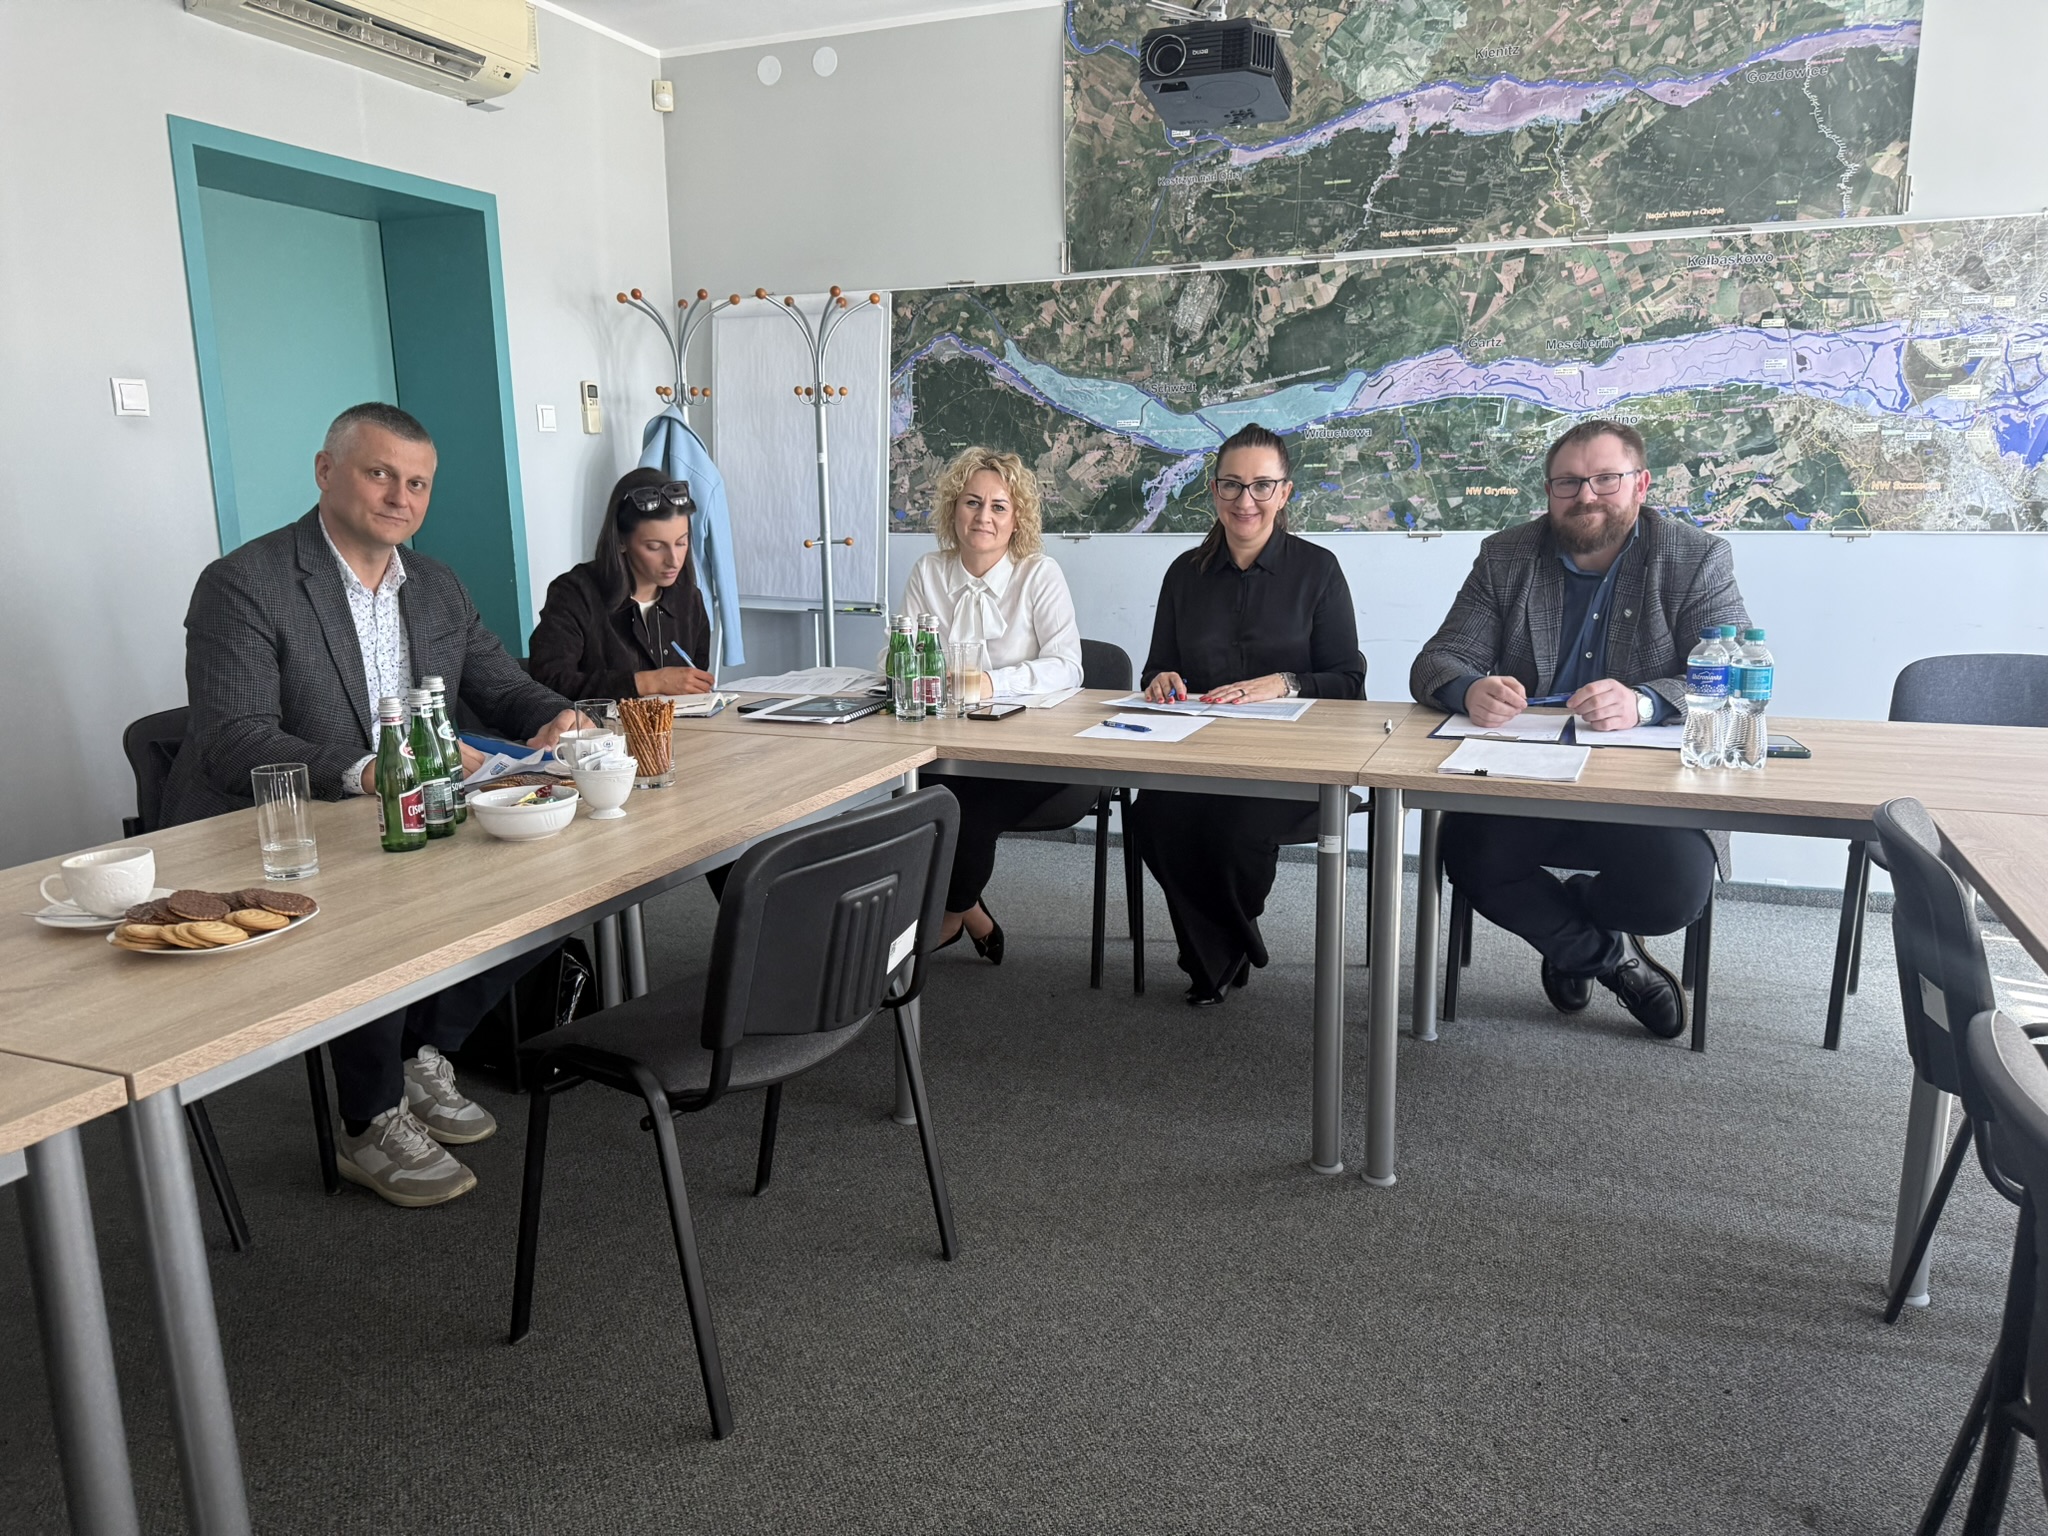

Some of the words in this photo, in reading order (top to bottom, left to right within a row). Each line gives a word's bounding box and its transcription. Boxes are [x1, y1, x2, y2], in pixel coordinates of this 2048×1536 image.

[1475, 44, 1520, 59] Kienitz
[1747, 65, 1829, 83] Gozdowice
[1157, 174, 1198, 187] Kostrzyn
[1200, 171, 1218, 182] nad
[1219, 169, 1243, 181] Odrą
[1646, 211, 1668, 220] Nadzór
[1669, 208, 1692, 218] Wodny
[1700, 206, 1725, 216] Chojnie
[1401, 228, 1420, 237] Wodny
[1468, 337, 1502, 348] Gartz
[1546, 337, 1614, 350] Mescherin
[1151, 382, 1198, 394] Schwedt
[1304, 427, 1373, 439] Widuchowa
[1465, 486, 1483, 496] NW
[1483, 486, 1519, 497] Gryfino
[1871, 480, 1891, 491] NW
